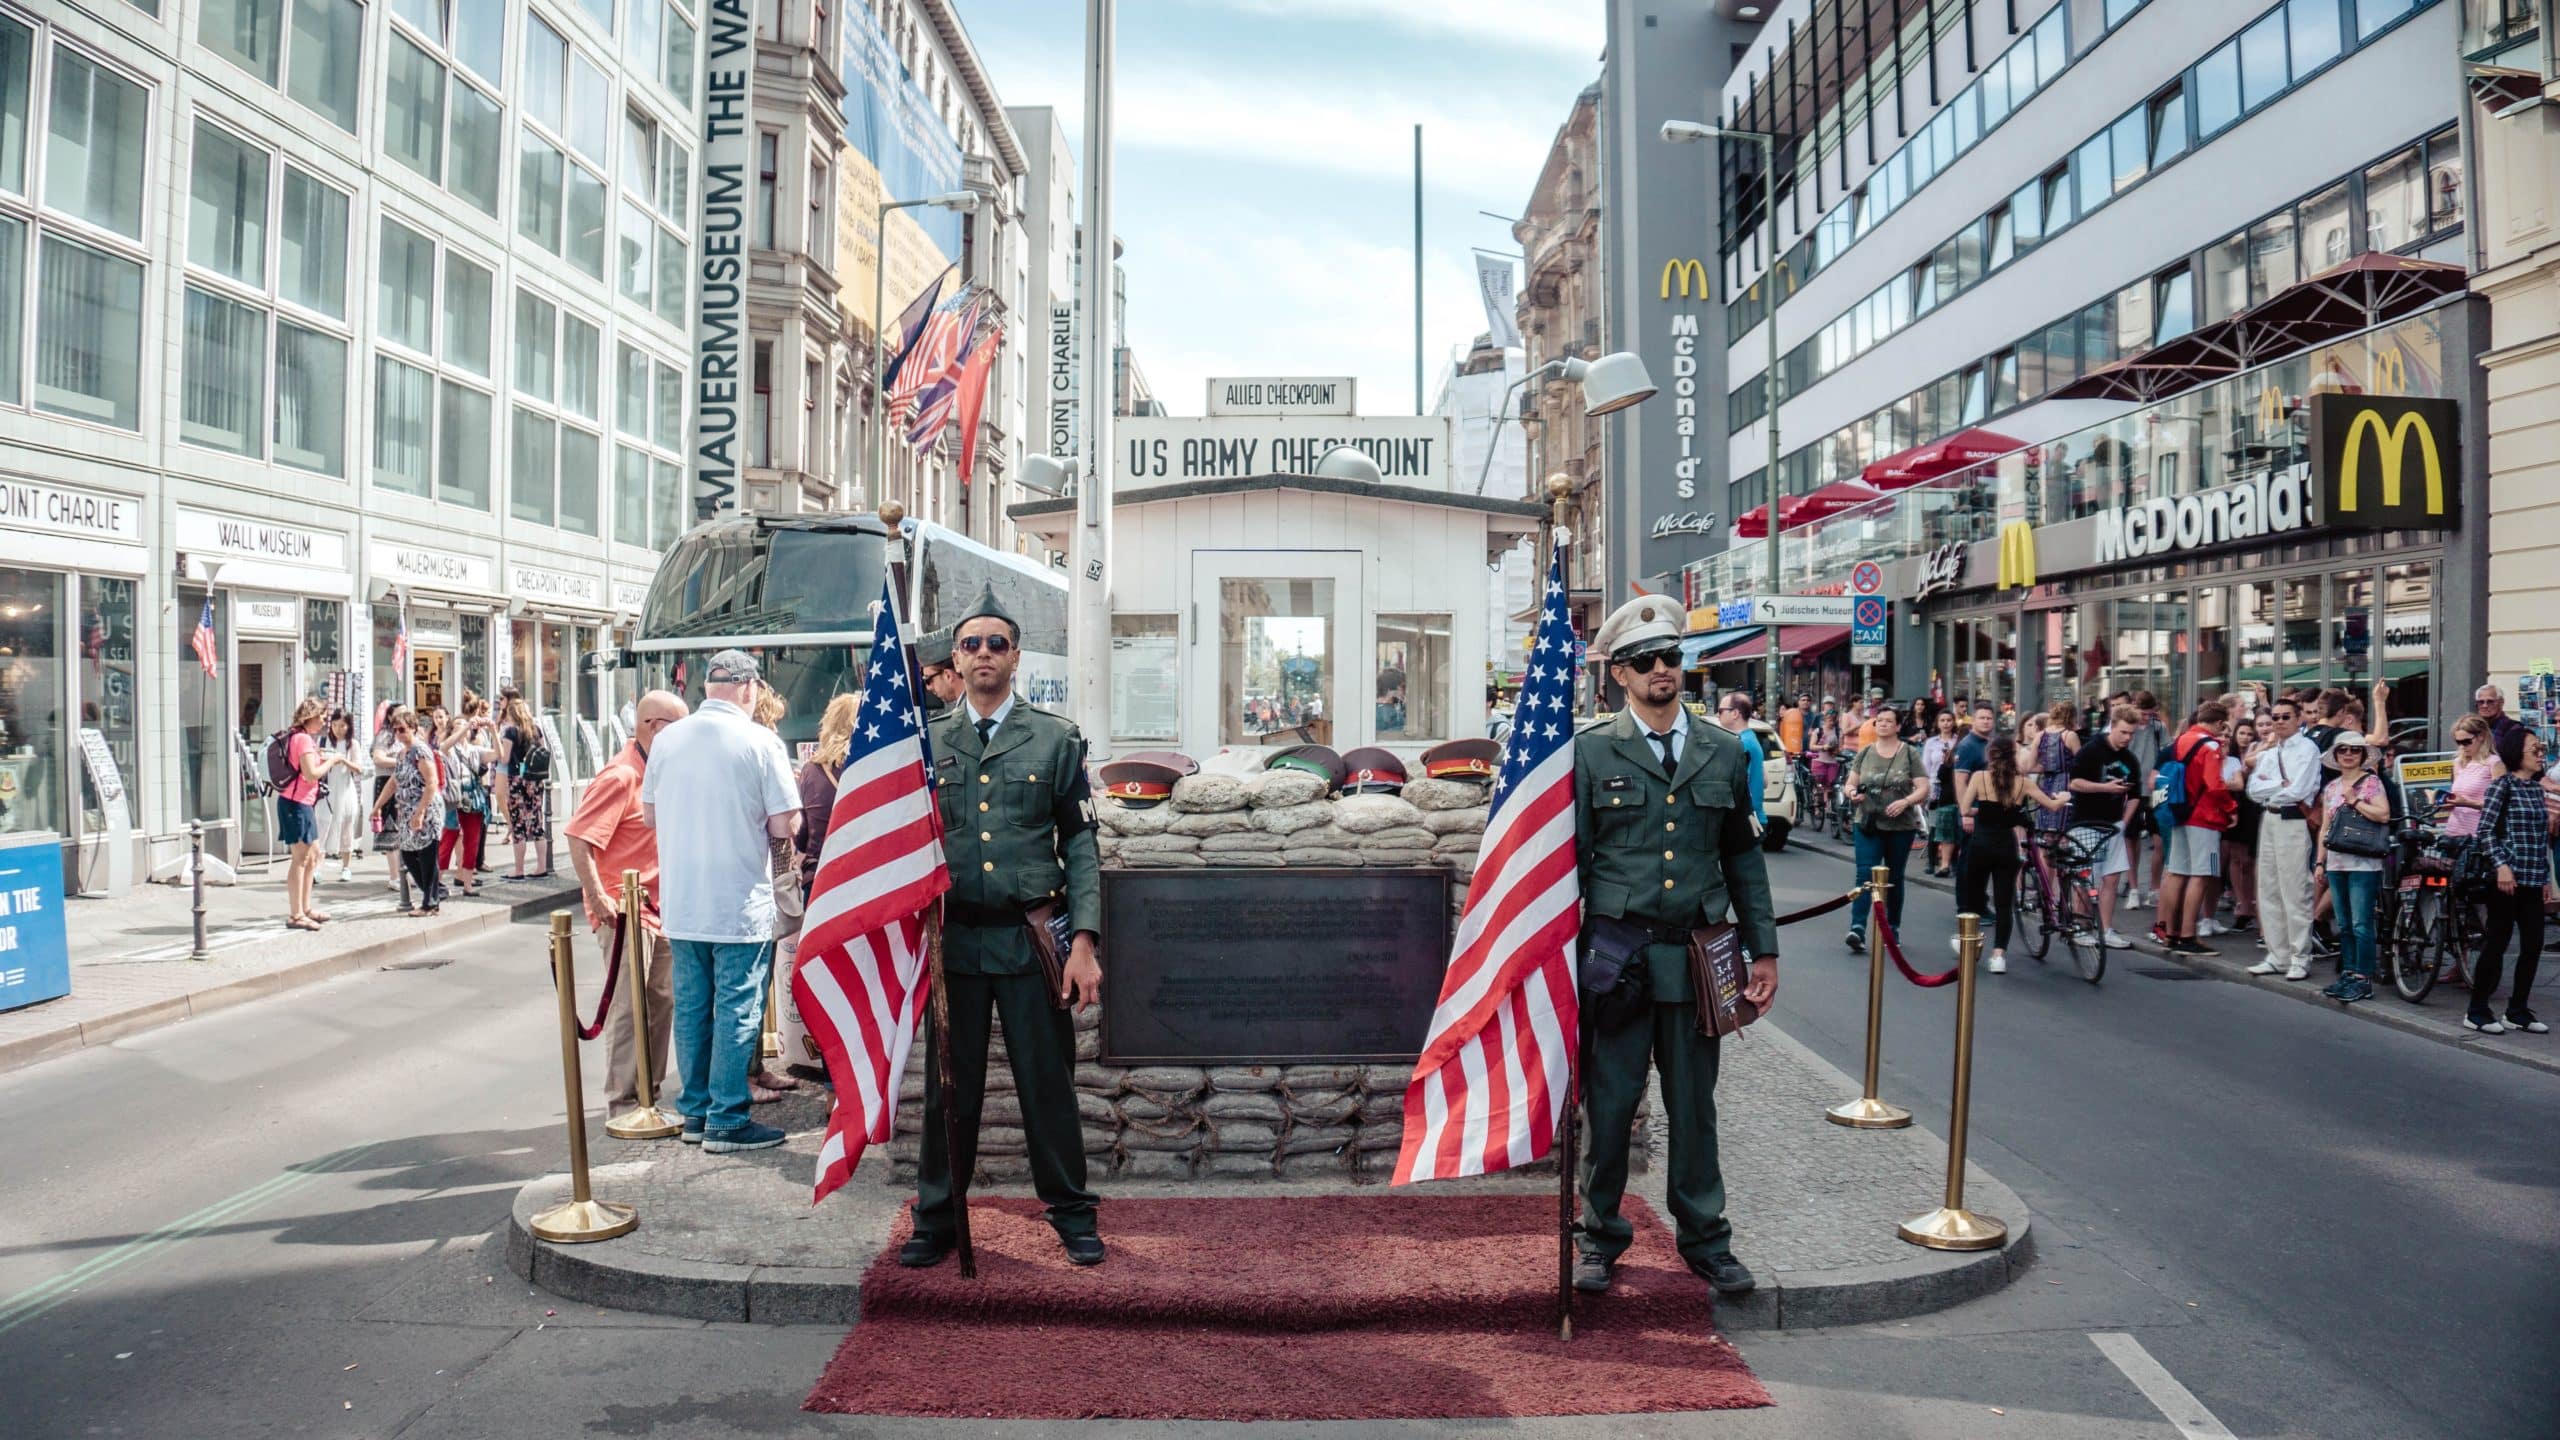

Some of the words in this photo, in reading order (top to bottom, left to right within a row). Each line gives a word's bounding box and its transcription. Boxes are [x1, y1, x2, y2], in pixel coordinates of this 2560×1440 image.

[707, 70, 745, 143] THE
[699, 164, 744, 510] MAUERMUSEUM
[1053, 309, 1070, 391] CHARLIE
[1226, 384, 1262, 405] ALLIED
[1267, 384, 1336, 405] CHECKPOINT
[1671, 314, 1702, 499] McDonald's
[1055, 400, 1069, 457] POINT
[1130, 438, 1168, 477] US
[1183, 438, 1258, 477] ARMY
[47, 493, 120, 532] CHARLIE
[1652, 511, 1716, 537] McCafé
[218, 521, 255, 551] WALL
[260, 528, 311, 559] MUSEUM
[397, 551, 467, 581] MAUERMUSEUM
[516, 569, 561, 594] CHECKPOINT
[252, 604, 281, 618] MUSEUM
[1856, 629, 1883, 642] TAXI
[2405, 766, 2436, 777] TICKETS
[12, 886, 43, 914] THE
